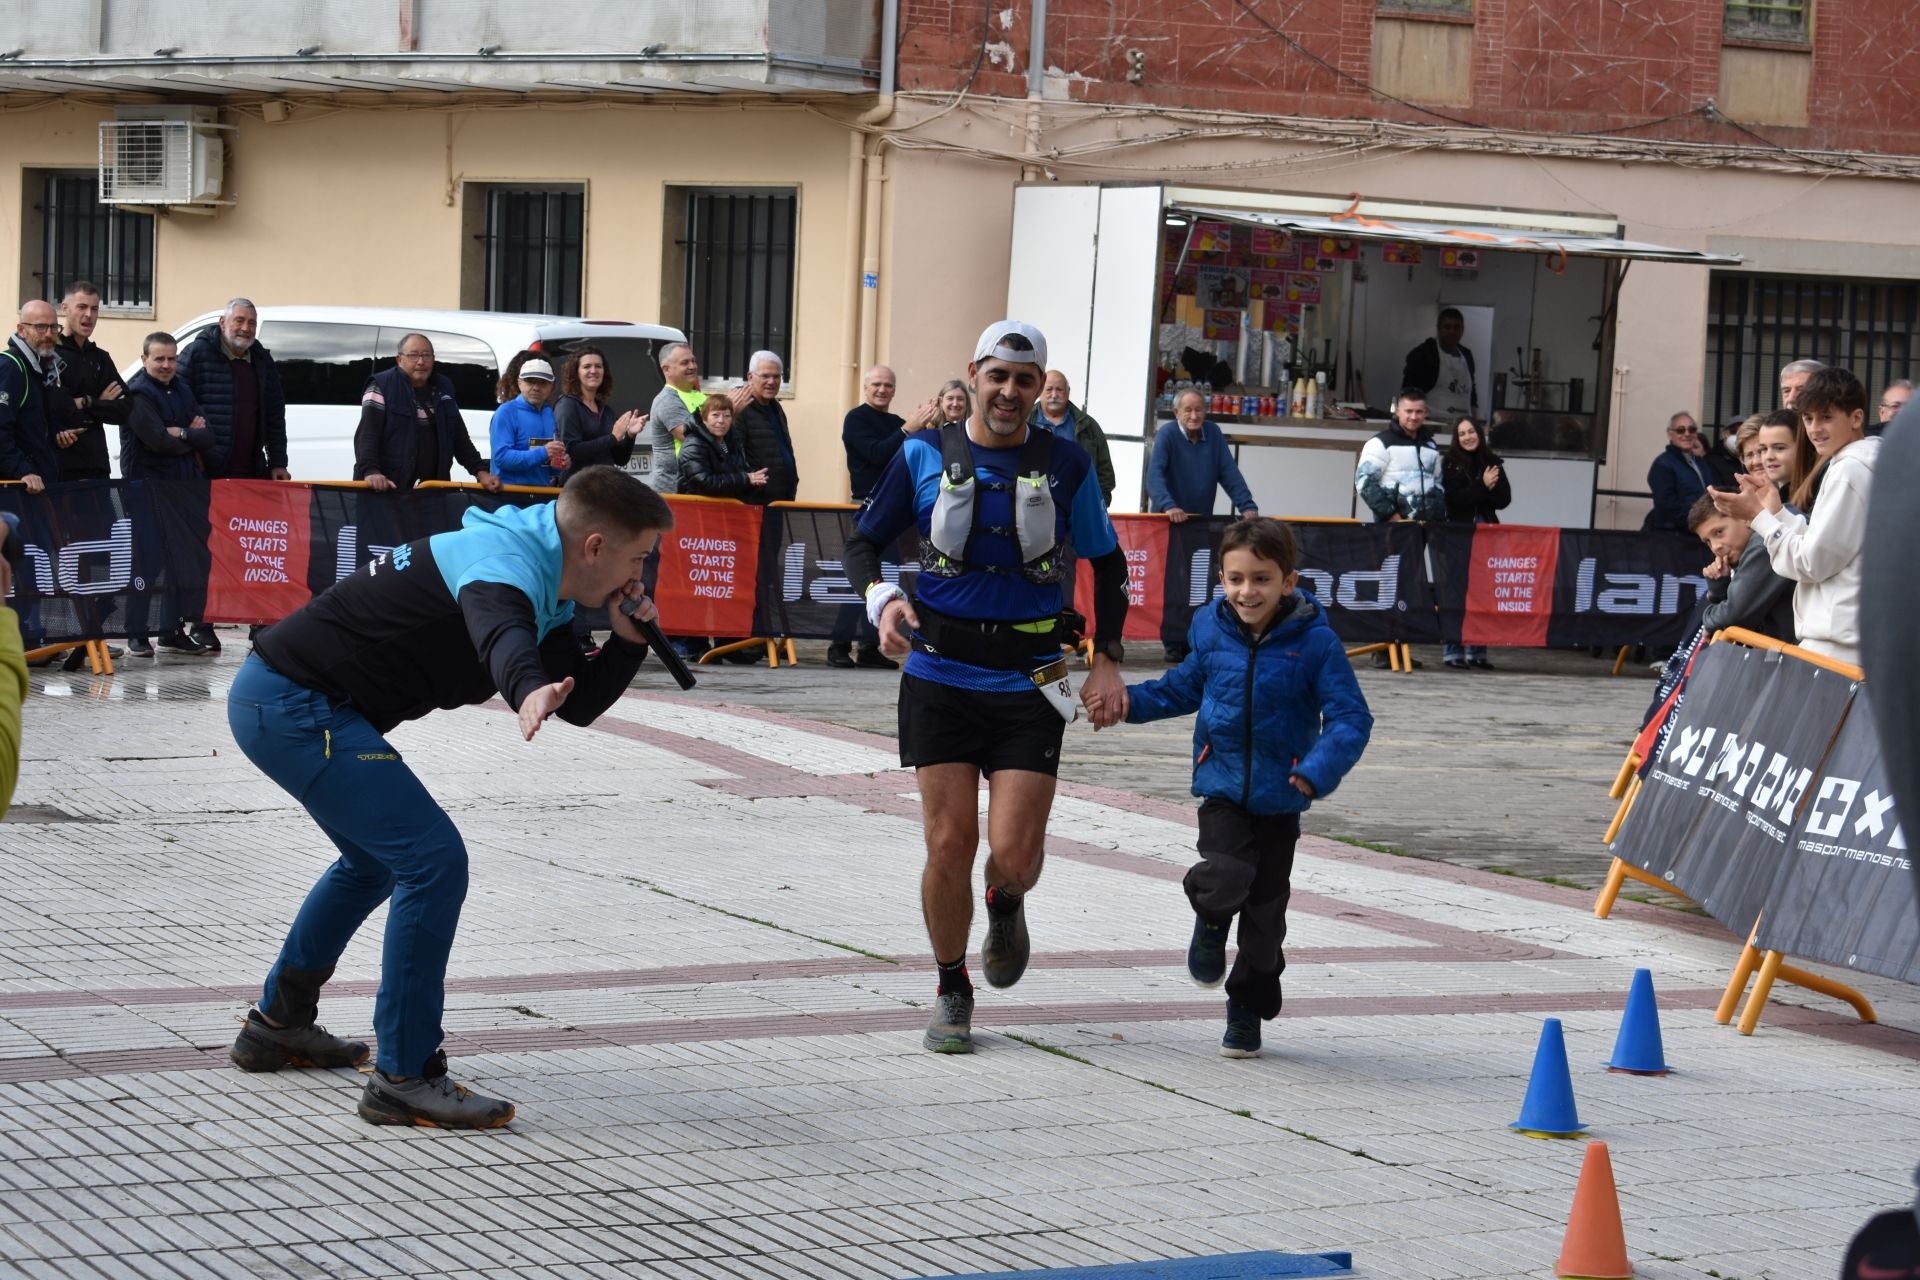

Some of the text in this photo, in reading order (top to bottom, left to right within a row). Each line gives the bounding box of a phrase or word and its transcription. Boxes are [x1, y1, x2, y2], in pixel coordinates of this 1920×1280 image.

[631, 457, 648, 470] GVB
[229, 517, 288, 534] CHANGES
[240, 536, 287, 552] STARTS
[680, 537, 736, 552] CHANGES
[261, 555, 285, 570] THE
[690, 553, 735, 569] STARTS
[1487, 557, 1537, 569] CHANGES
[245, 569, 289, 583] INSIDE
[689, 568, 735, 583] ON THE
[1495, 572, 1535, 584] STARTS
[694, 585, 735, 599] INSIDE
[1494, 587, 1533, 599] ON THE
[1575, 558, 1708, 614] lan
[1497, 601, 1533, 612] INSIDE
